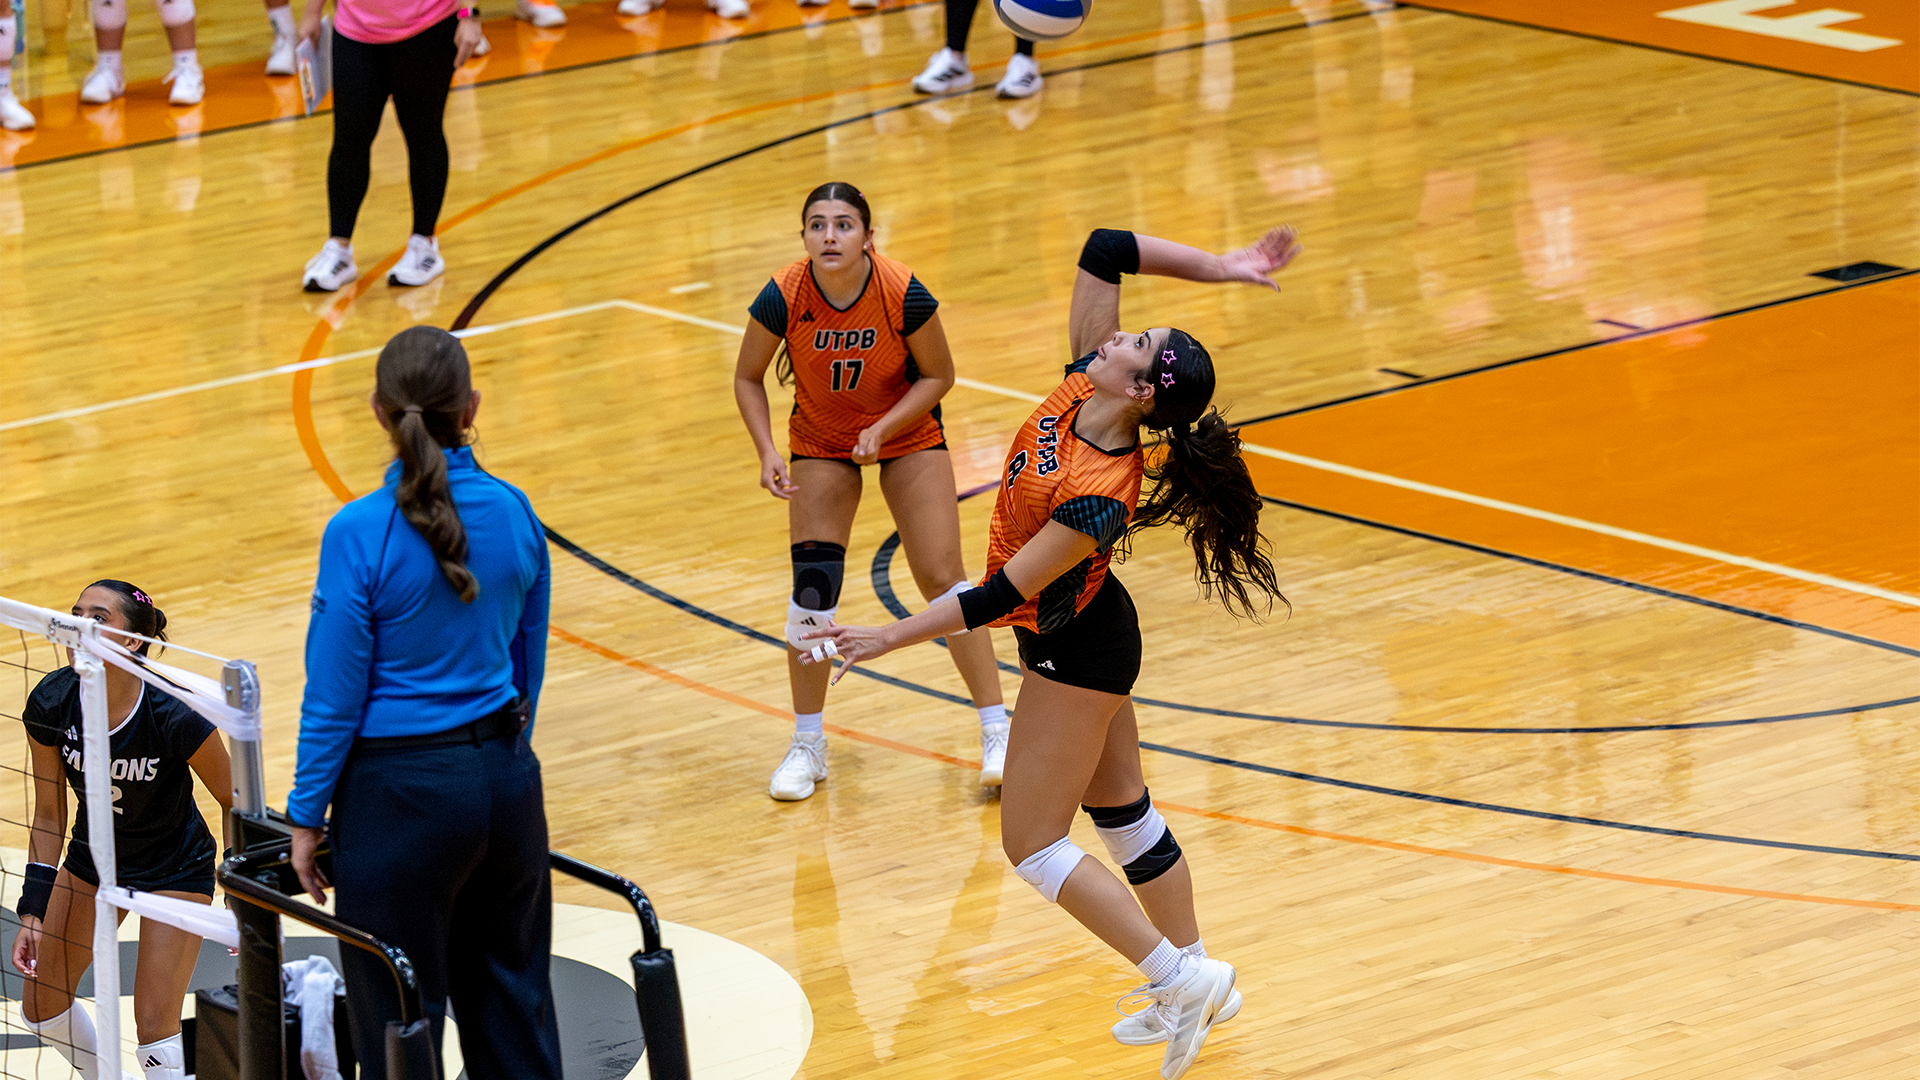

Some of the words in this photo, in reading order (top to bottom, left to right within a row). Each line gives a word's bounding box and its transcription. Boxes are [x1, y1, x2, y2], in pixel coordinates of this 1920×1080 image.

[813, 327, 877, 351] UTPB
[830, 358, 864, 392] 17
[1037, 415, 1059, 477] UTPB
[62, 744, 160, 781] FAONS
